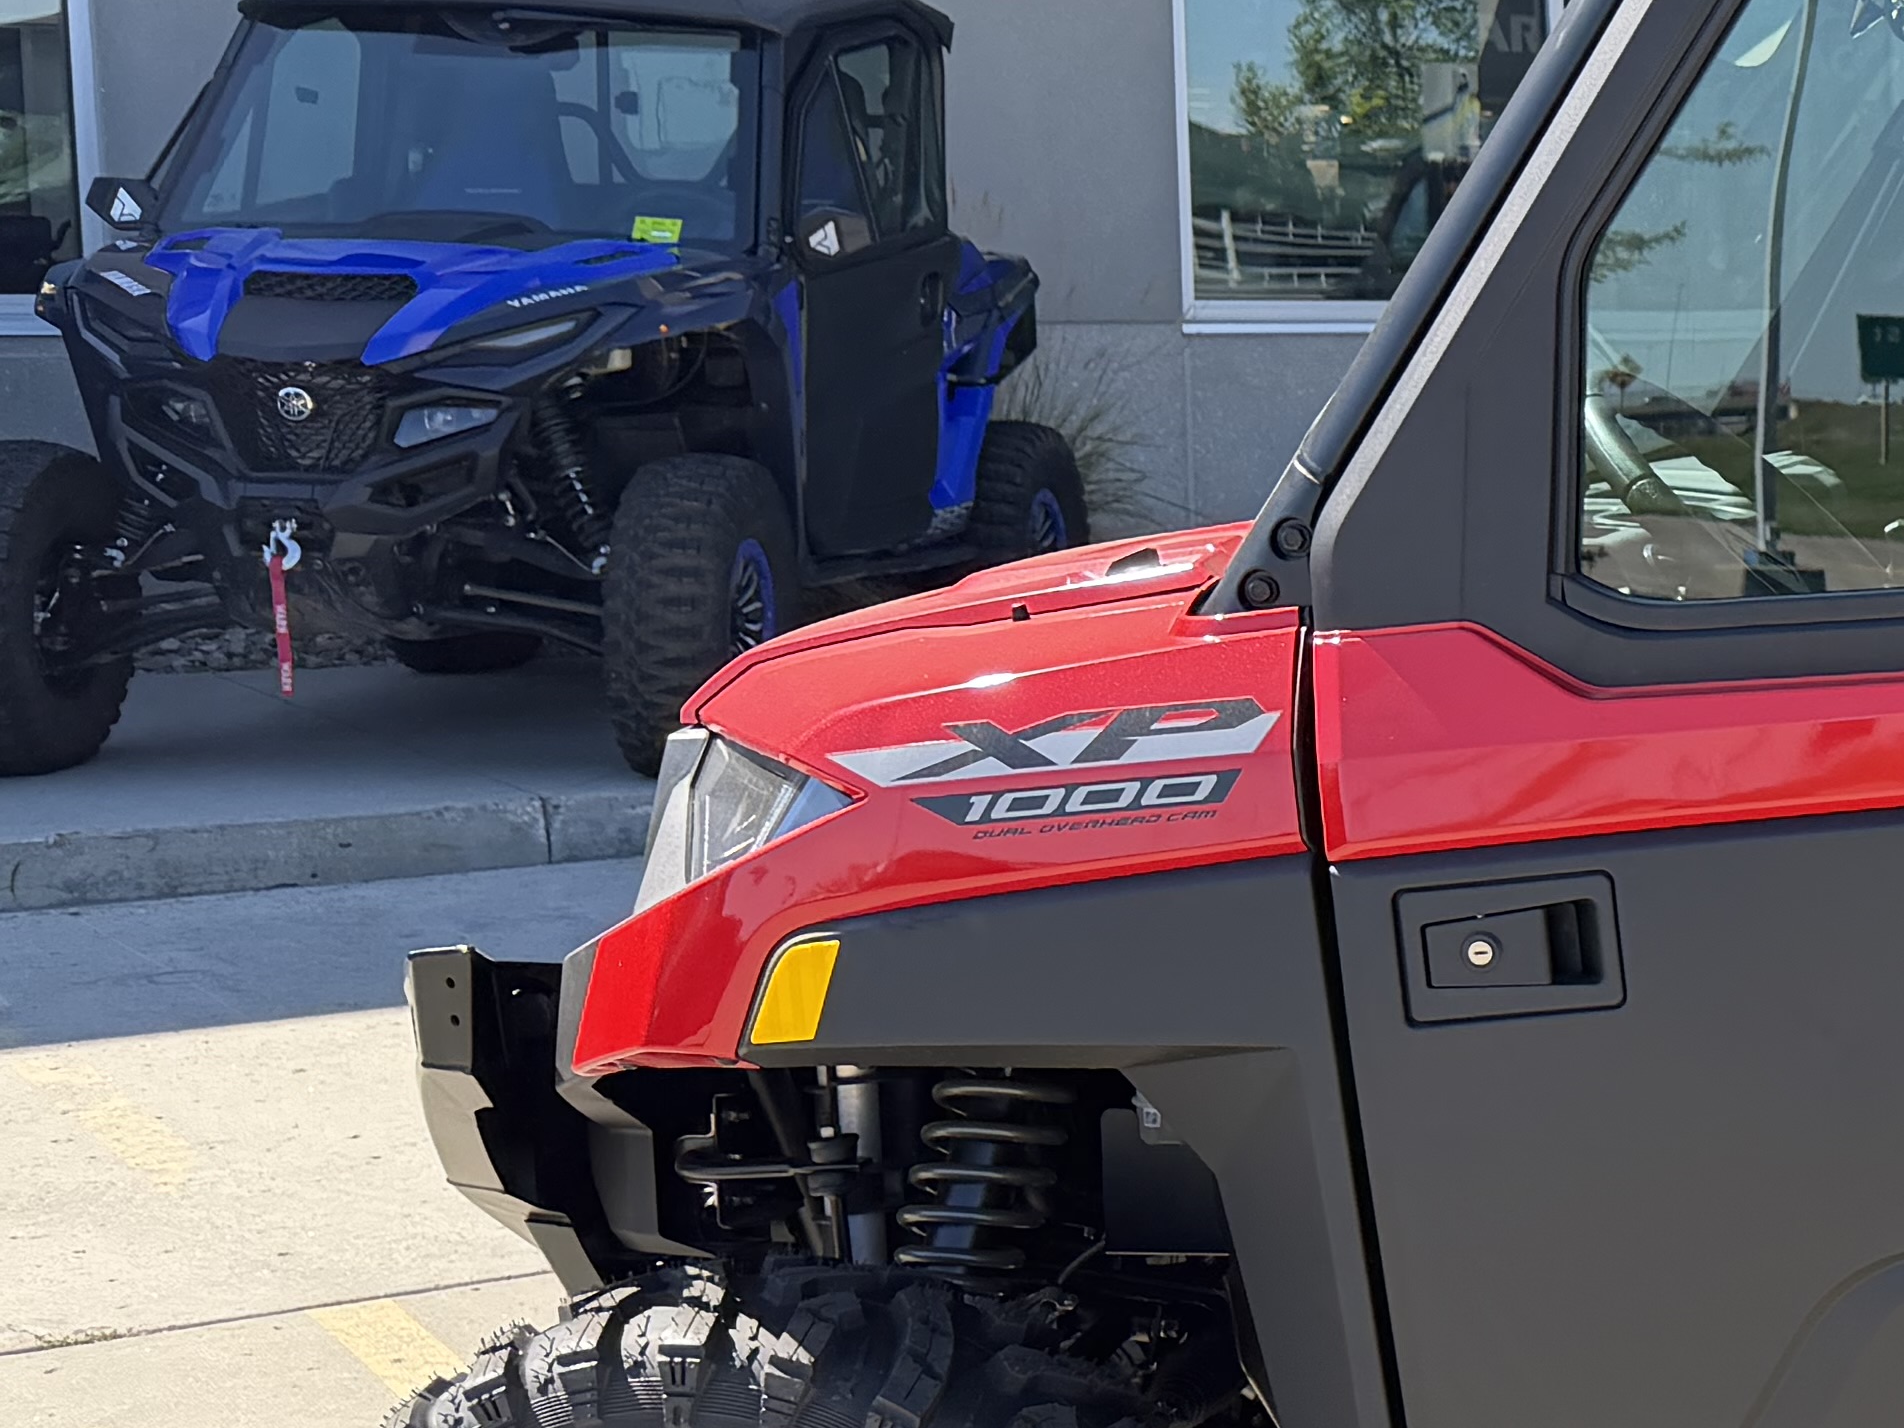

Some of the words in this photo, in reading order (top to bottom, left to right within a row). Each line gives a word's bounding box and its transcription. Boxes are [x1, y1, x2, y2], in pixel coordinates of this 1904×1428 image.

[506, 284, 590, 309] YAMAHA
[891, 696, 1267, 783] XP
[964, 774, 1218, 822] 1000
[972, 827, 1033, 841] DUAL
[1039, 814, 1161, 835] OVERHEAD
[1166, 809, 1218, 823] CAM
